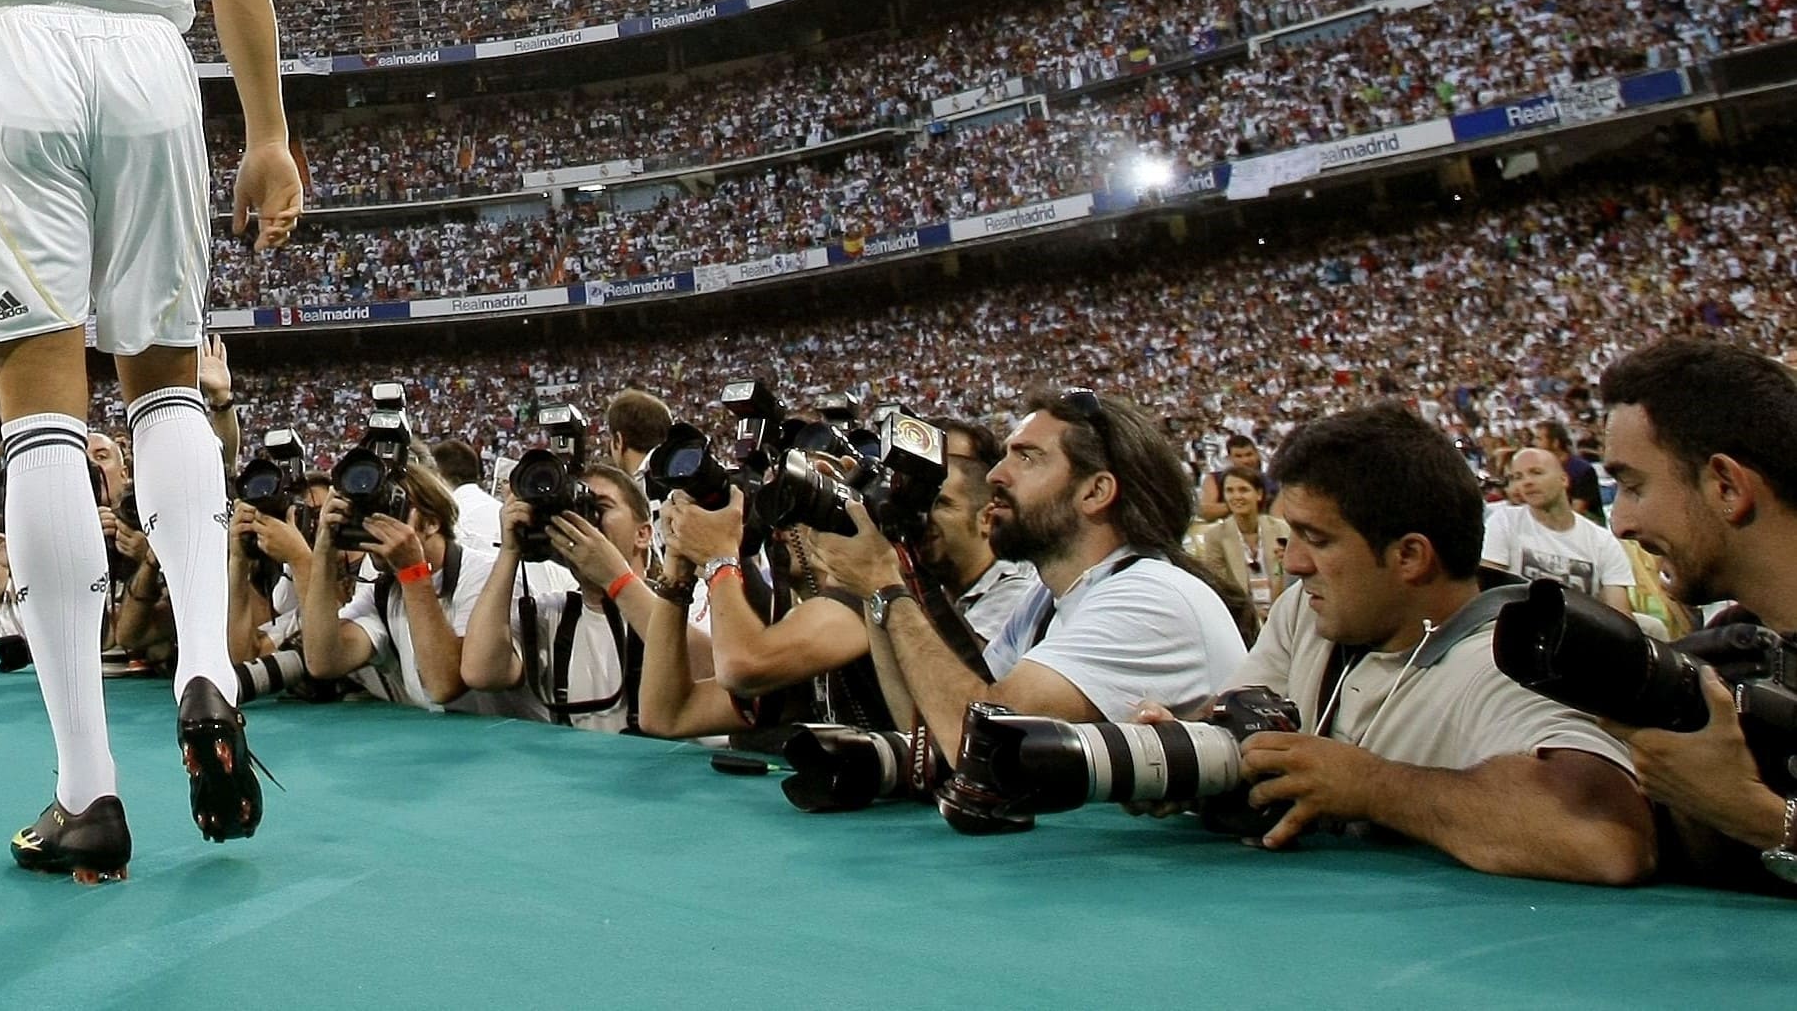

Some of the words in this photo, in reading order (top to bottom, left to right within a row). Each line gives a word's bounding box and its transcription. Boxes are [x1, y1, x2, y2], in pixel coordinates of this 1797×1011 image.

[652, 5, 717, 30] Realmadrid
[514, 32, 581, 52] Realmadrid
[379, 51, 439, 66] ealmadrid
[1320, 133, 1399, 165] ealmadrid
[862, 232, 918, 256] ealmadrid
[452, 297, 528, 313] Realmadrid
[913, 725, 926, 790] Canon
